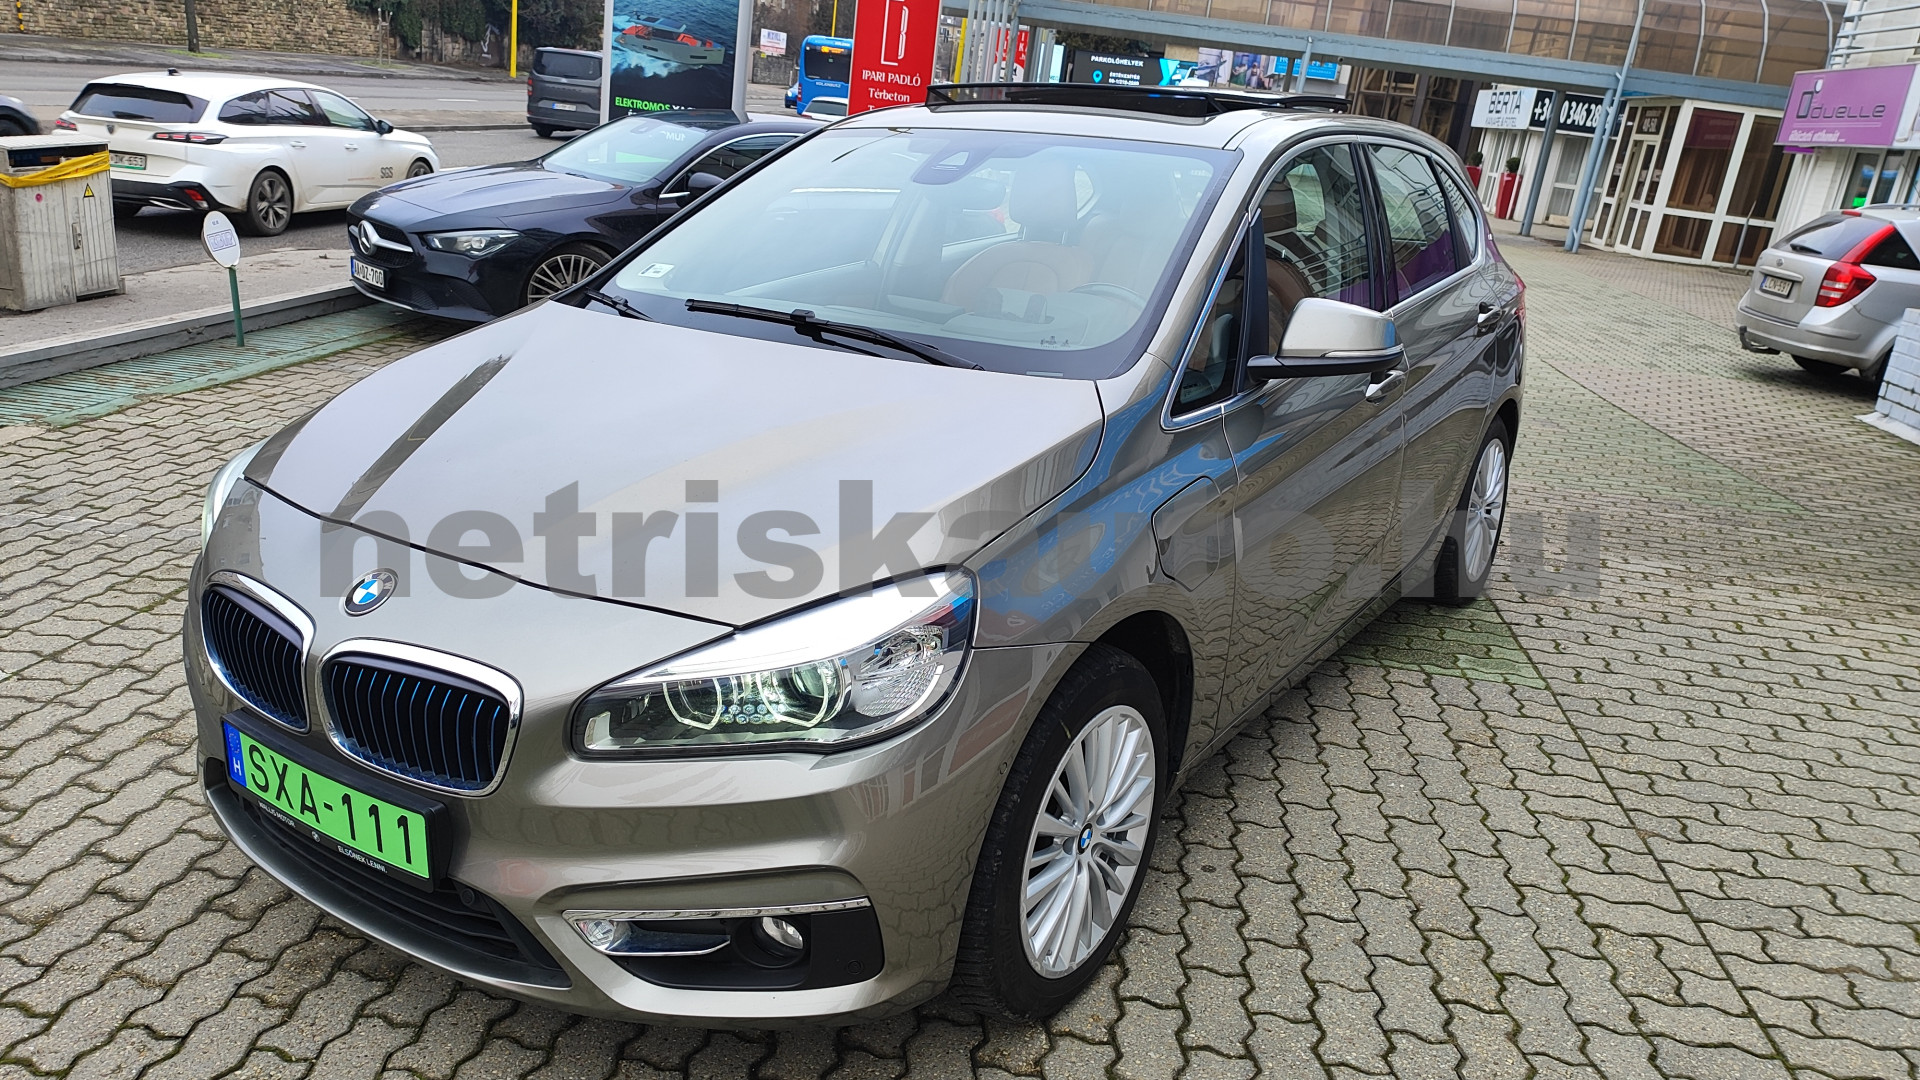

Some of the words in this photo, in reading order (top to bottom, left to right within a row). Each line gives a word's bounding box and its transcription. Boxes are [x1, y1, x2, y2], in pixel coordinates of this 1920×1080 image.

[862, 69, 886, 82] IPARI
[888, 72, 921, 87] PADLÓ
[615, 96, 671, 111] ELEKTROMOS
[868, 87, 910, 103] Térbeton
[1488, 90, 1522, 114] BERTA
[380, 166, 394, 179] SGS
[233, 757, 242, 777] H
[248, 743, 412, 865] SXA-111
